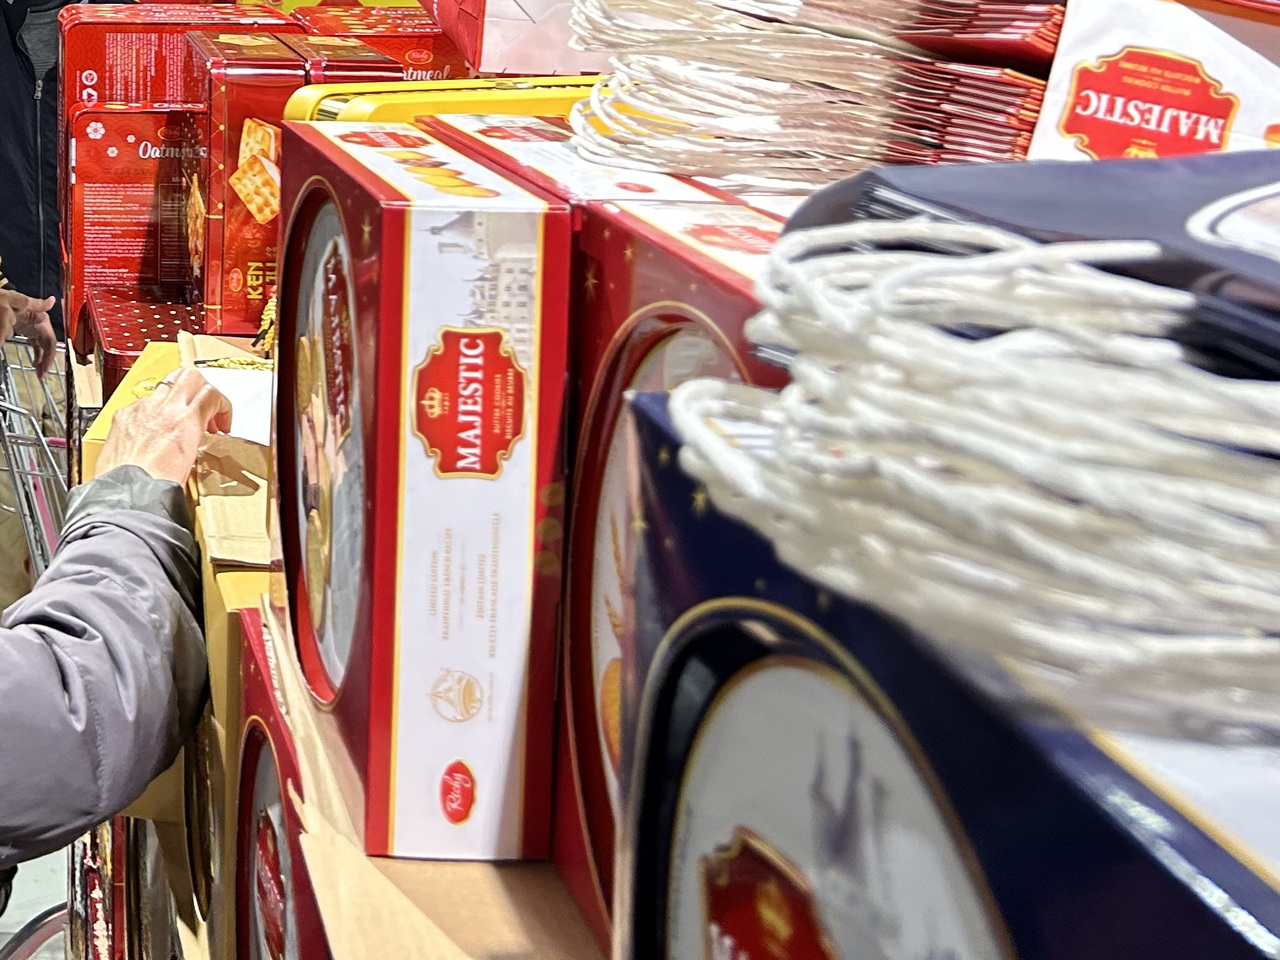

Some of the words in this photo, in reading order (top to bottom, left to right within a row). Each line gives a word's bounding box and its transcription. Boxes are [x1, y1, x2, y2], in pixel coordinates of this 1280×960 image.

[403, 65, 451, 81] atmeal
[1074, 90, 1225, 143] MAJESTIC
[247, 262, 263, 299] KEN
[456, 337, 486, 470] MAJESTIC
[444, 772, 472, 813] Richy
